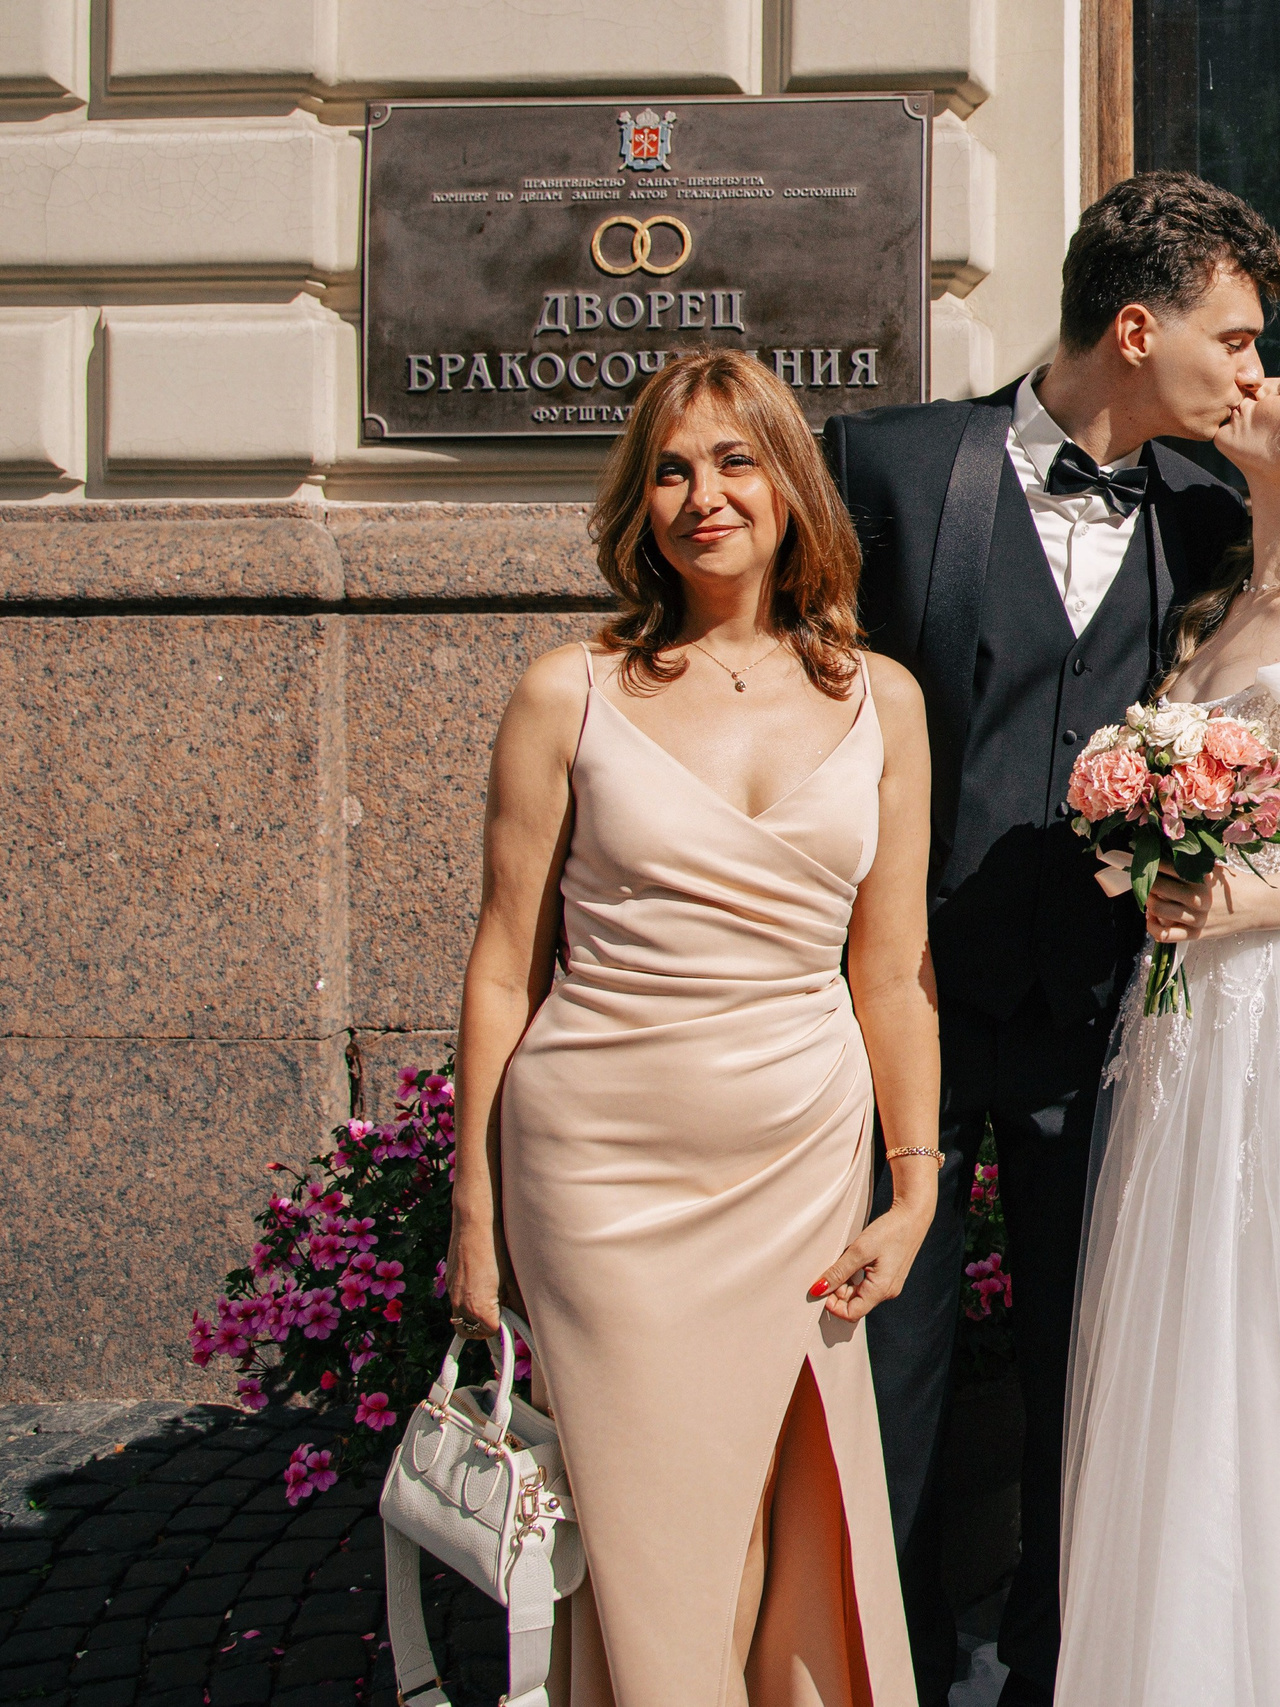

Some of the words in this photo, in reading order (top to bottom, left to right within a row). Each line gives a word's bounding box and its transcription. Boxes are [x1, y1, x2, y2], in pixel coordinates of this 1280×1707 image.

[523, 178, 626, 189] ПРАВИТЕЛЬСТВО
[432, 192, 489, 202] КОМИТЕТ
[496, 192, 514, 201] ПО
[520, 191, 563, 203] ДЕЛАМ
[571, 190, 620, 200] ЗАПИСИ
[628, 189, 668, 199] АКТОВ
[676, 188, 775, 199] ГРАЖДАНСКОГО
[783, 187, 858, 198] СОСТОЯНИЯ
[535, 291, 746, 336] ДВОРЕЦ
[407, 348, 879, 391] БРАКОСОЧНИЯ
[532, 405, 636, 422] ФУРШТАТ
